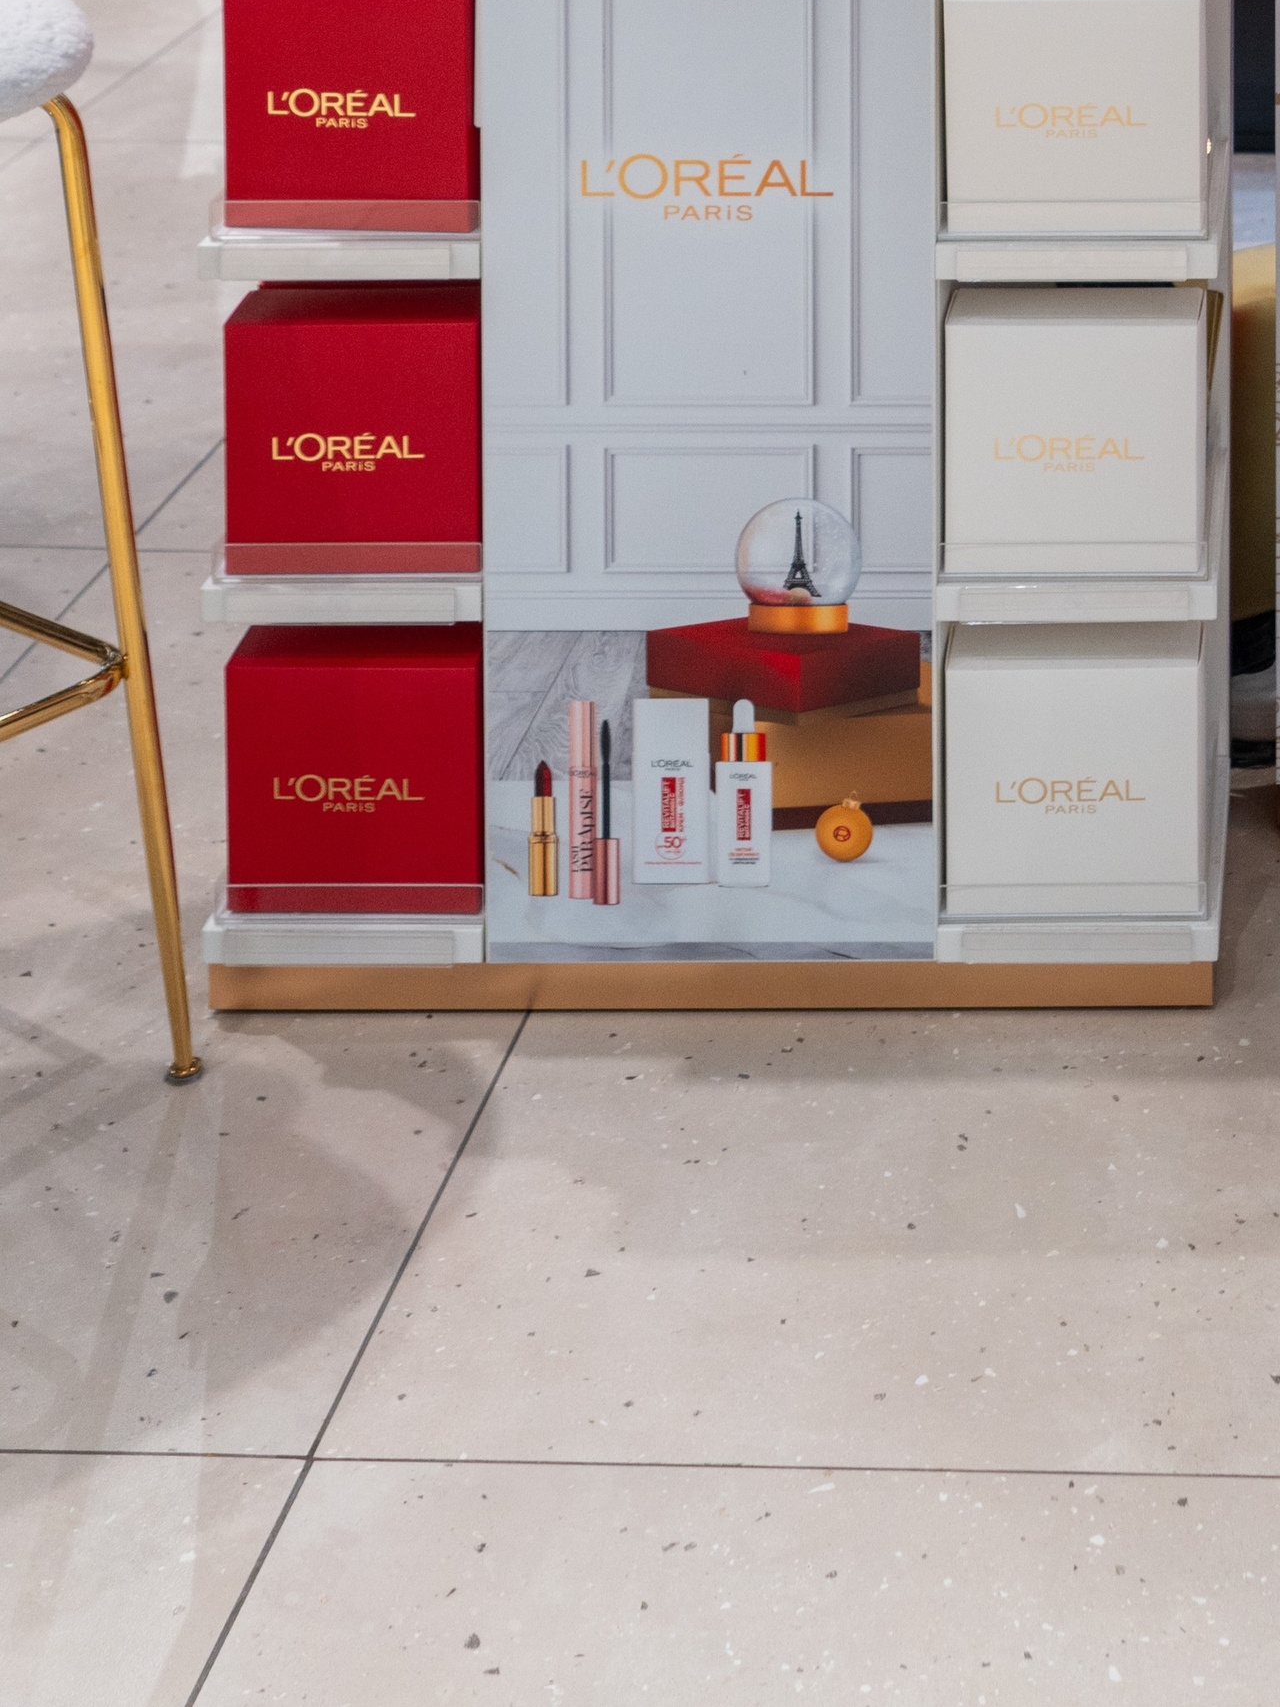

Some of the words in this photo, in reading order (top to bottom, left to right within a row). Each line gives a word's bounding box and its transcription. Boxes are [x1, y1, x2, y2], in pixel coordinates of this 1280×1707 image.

[267, 88, 416, 117] L'ORÉAL
[995, 102, 1147, 129] L'ORÉAL
[580, 153, 835, 200] L'ORÉAL
[271, 432, 425, 462] L'ORÉAL
[994, 434, 1145, 462] L'ORÉAL
[272, 774, 425, 801] L'ORÉAL
[995, 777, 1146, 804] L'ORÉAL
[578, 789, 595, 872] PARADISE
